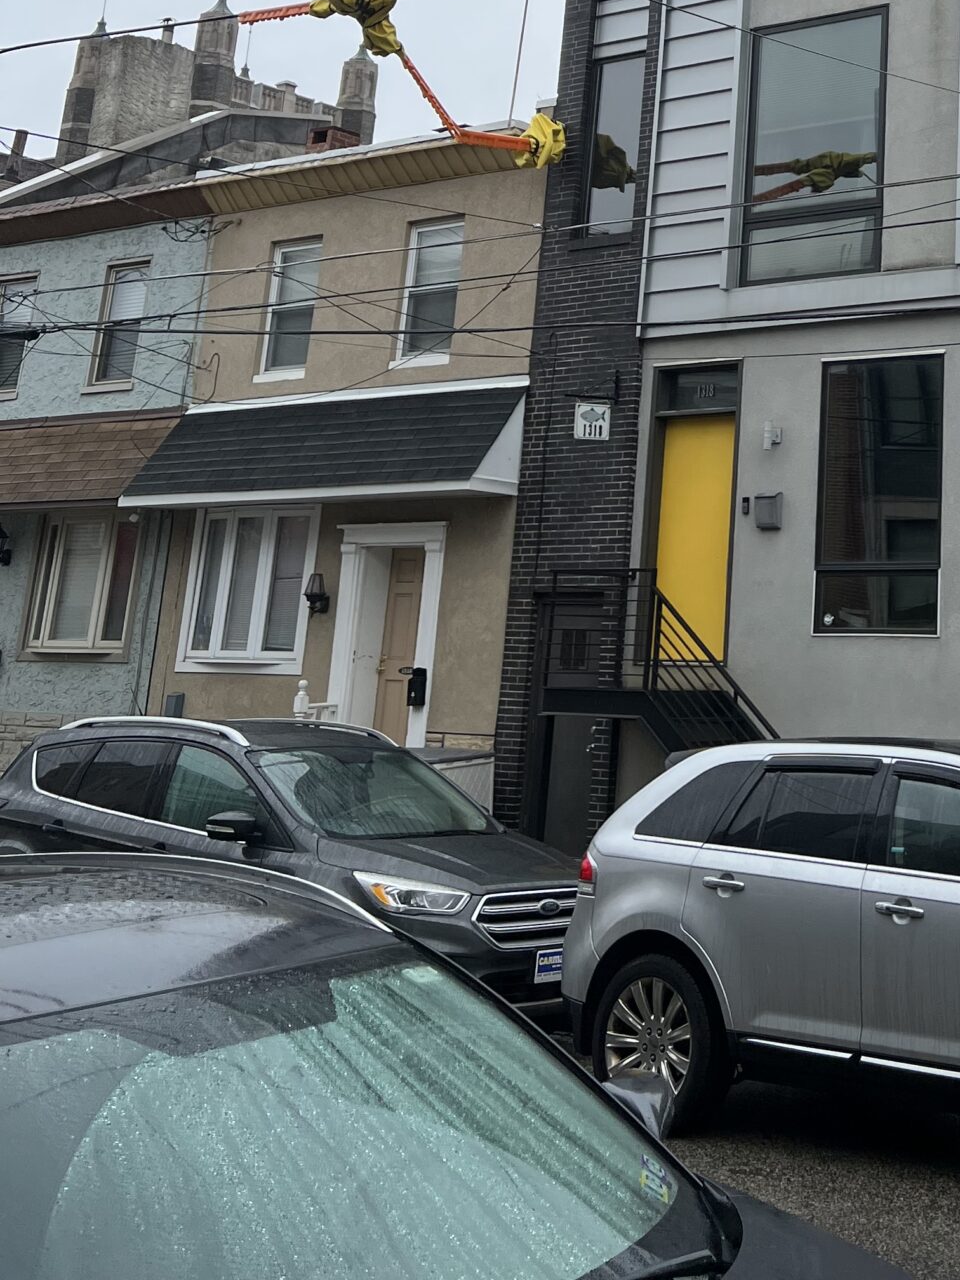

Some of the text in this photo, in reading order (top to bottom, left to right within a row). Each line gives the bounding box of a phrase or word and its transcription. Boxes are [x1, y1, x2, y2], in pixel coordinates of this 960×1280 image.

[697, 384, 714, 399] 1318
[583, 423, 603, 437] 1318
[539, 955, 562, 966] CARM
